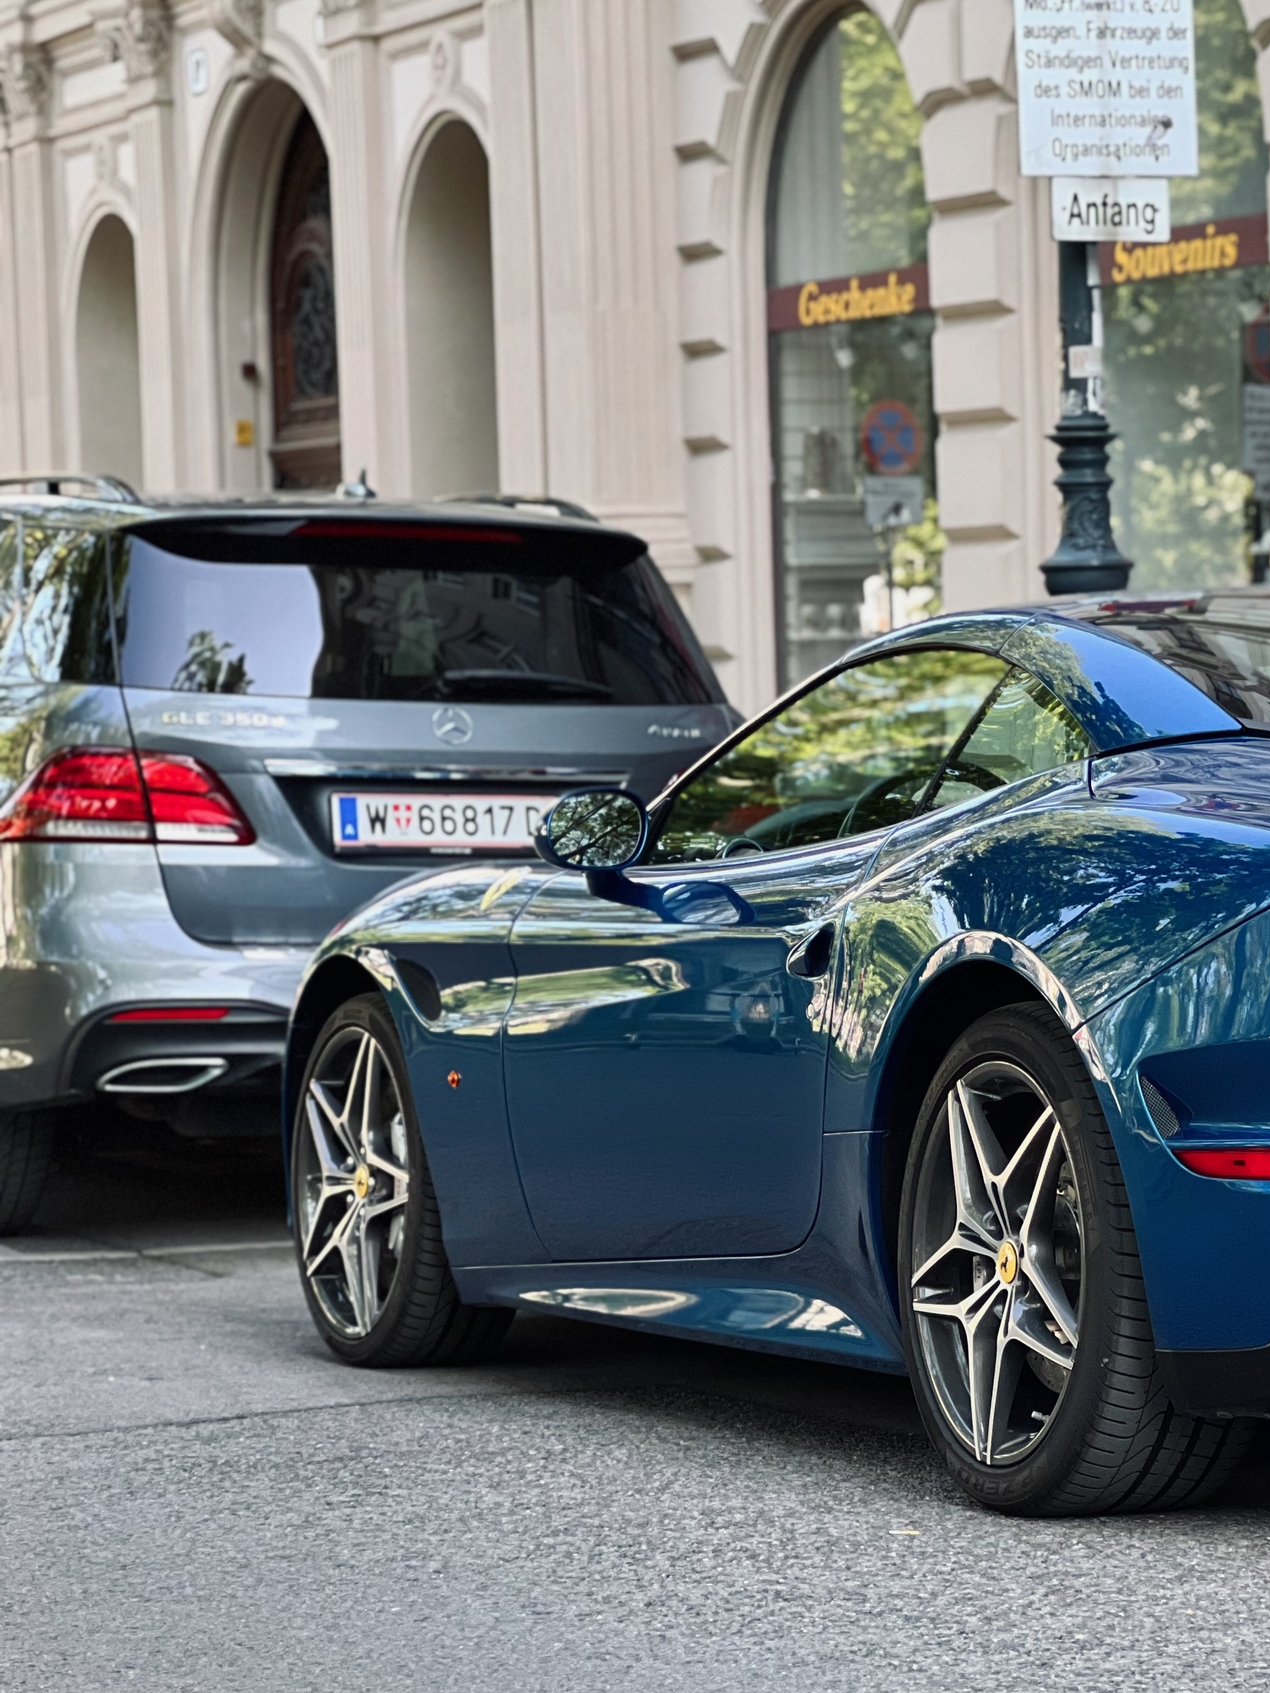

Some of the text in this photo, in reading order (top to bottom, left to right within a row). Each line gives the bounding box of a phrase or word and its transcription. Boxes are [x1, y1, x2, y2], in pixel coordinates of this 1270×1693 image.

[1086, 21, 1162, 44] Fahrzeuge
[1166, 21, 1188, 40] der
[1024, 50, 1190, 74] Ständigen Vertretung
[1034, 79, 1184, 99] des SMOM bei den
[1052, 137, 1171, 160] Organisationen
[1067, 192, 1157, 234] Anfang
[1111, 222, 1239, 284] Souvenirs
[798, 270, 916, 327] Geschenke
[161, 710, 211, 726] GLE
[366, 804, 388, 835] W
[418, 804, 514, 836] 66817
